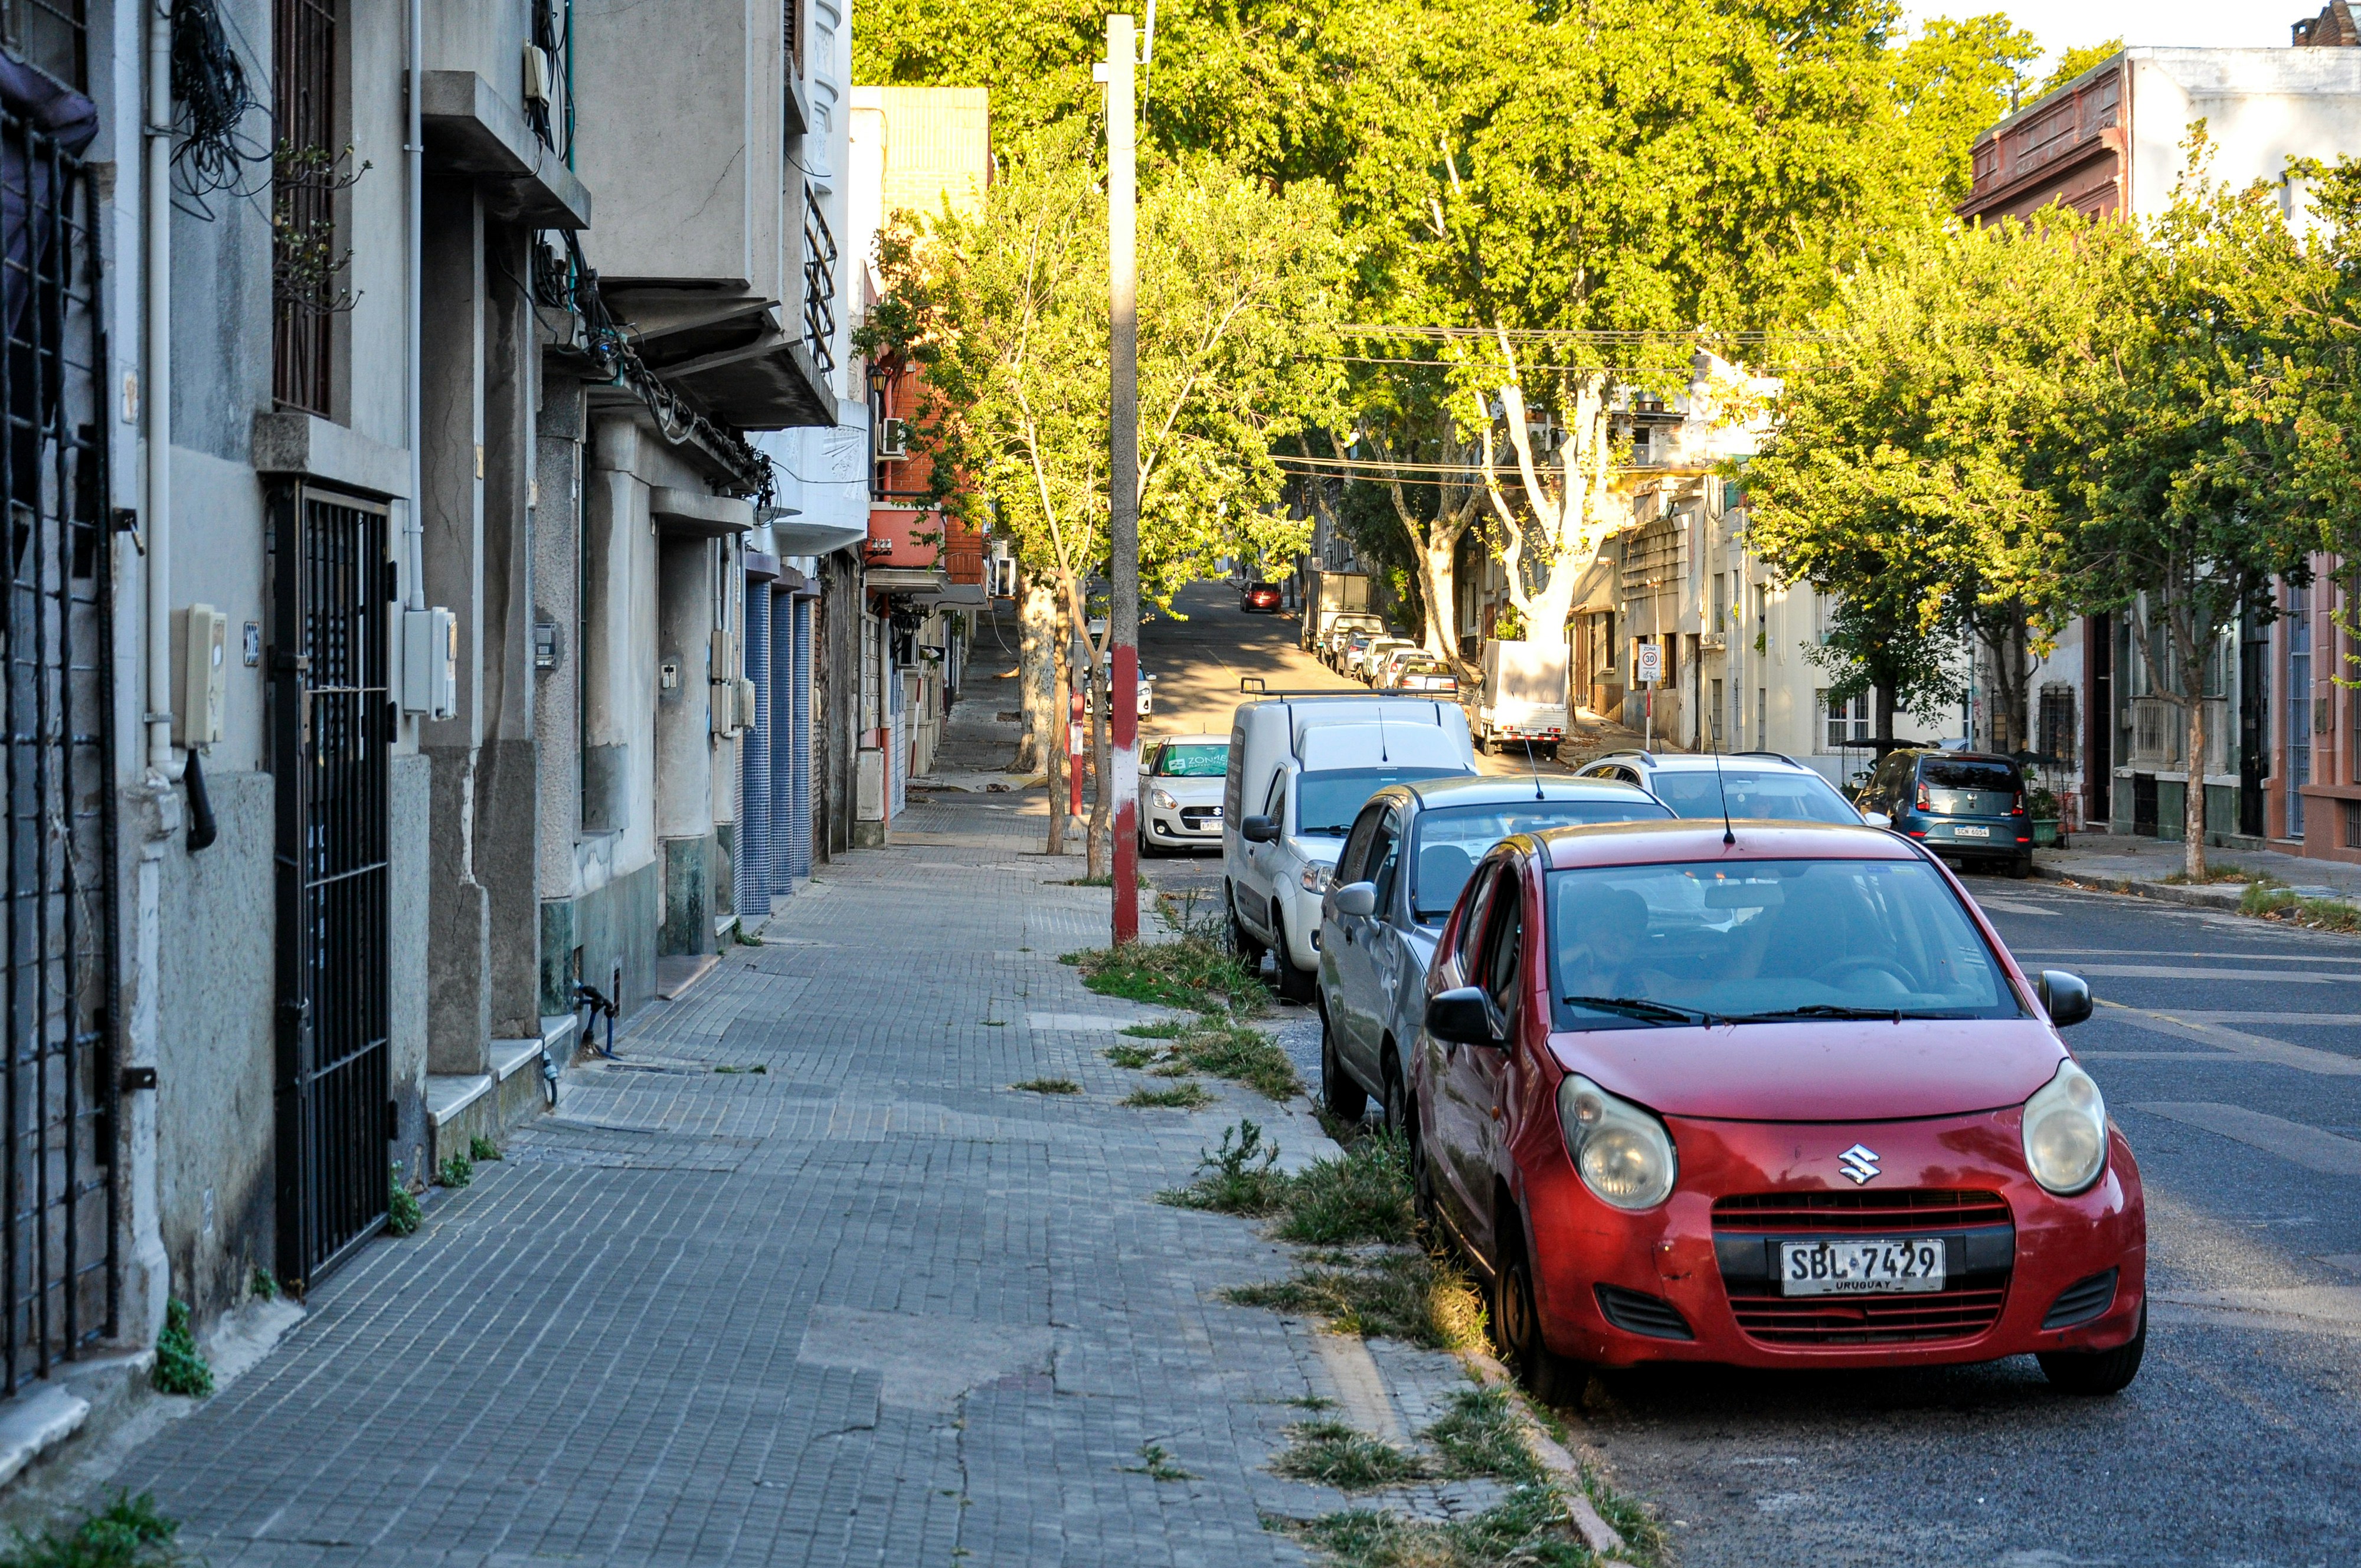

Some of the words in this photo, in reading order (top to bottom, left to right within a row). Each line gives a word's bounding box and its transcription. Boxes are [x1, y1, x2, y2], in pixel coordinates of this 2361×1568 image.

[1791, 1246, 1848, 1281] SBL
[1860, 1246, 1936, 1280] 7429
[1836, 1280, 1891, 1290] URUGUAY
